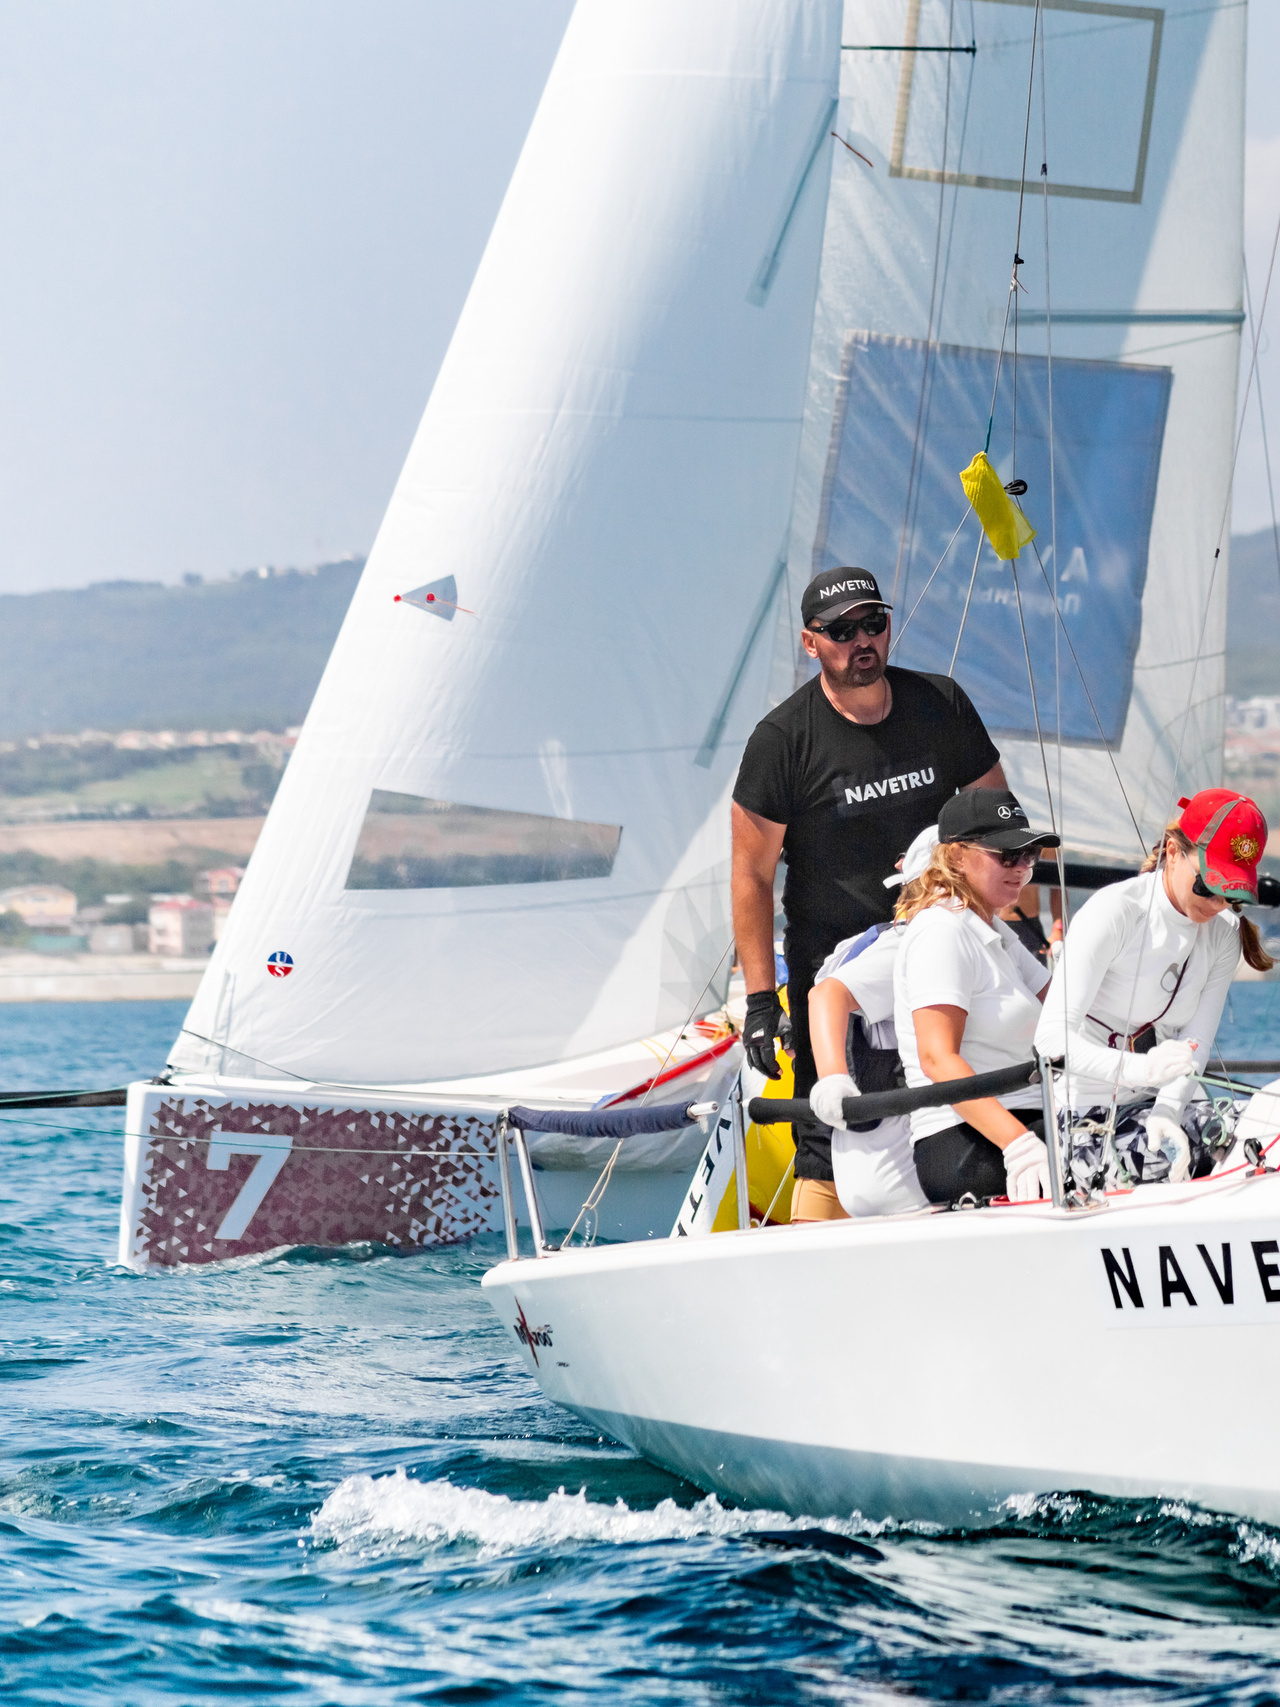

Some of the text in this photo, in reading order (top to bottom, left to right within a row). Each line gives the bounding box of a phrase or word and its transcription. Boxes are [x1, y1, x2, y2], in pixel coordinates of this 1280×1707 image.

[819, 579, 875, 600] NAVETRU
[844, 767, 935, 804] NAVETRU
[206, 1130, 293, 1240] 7
